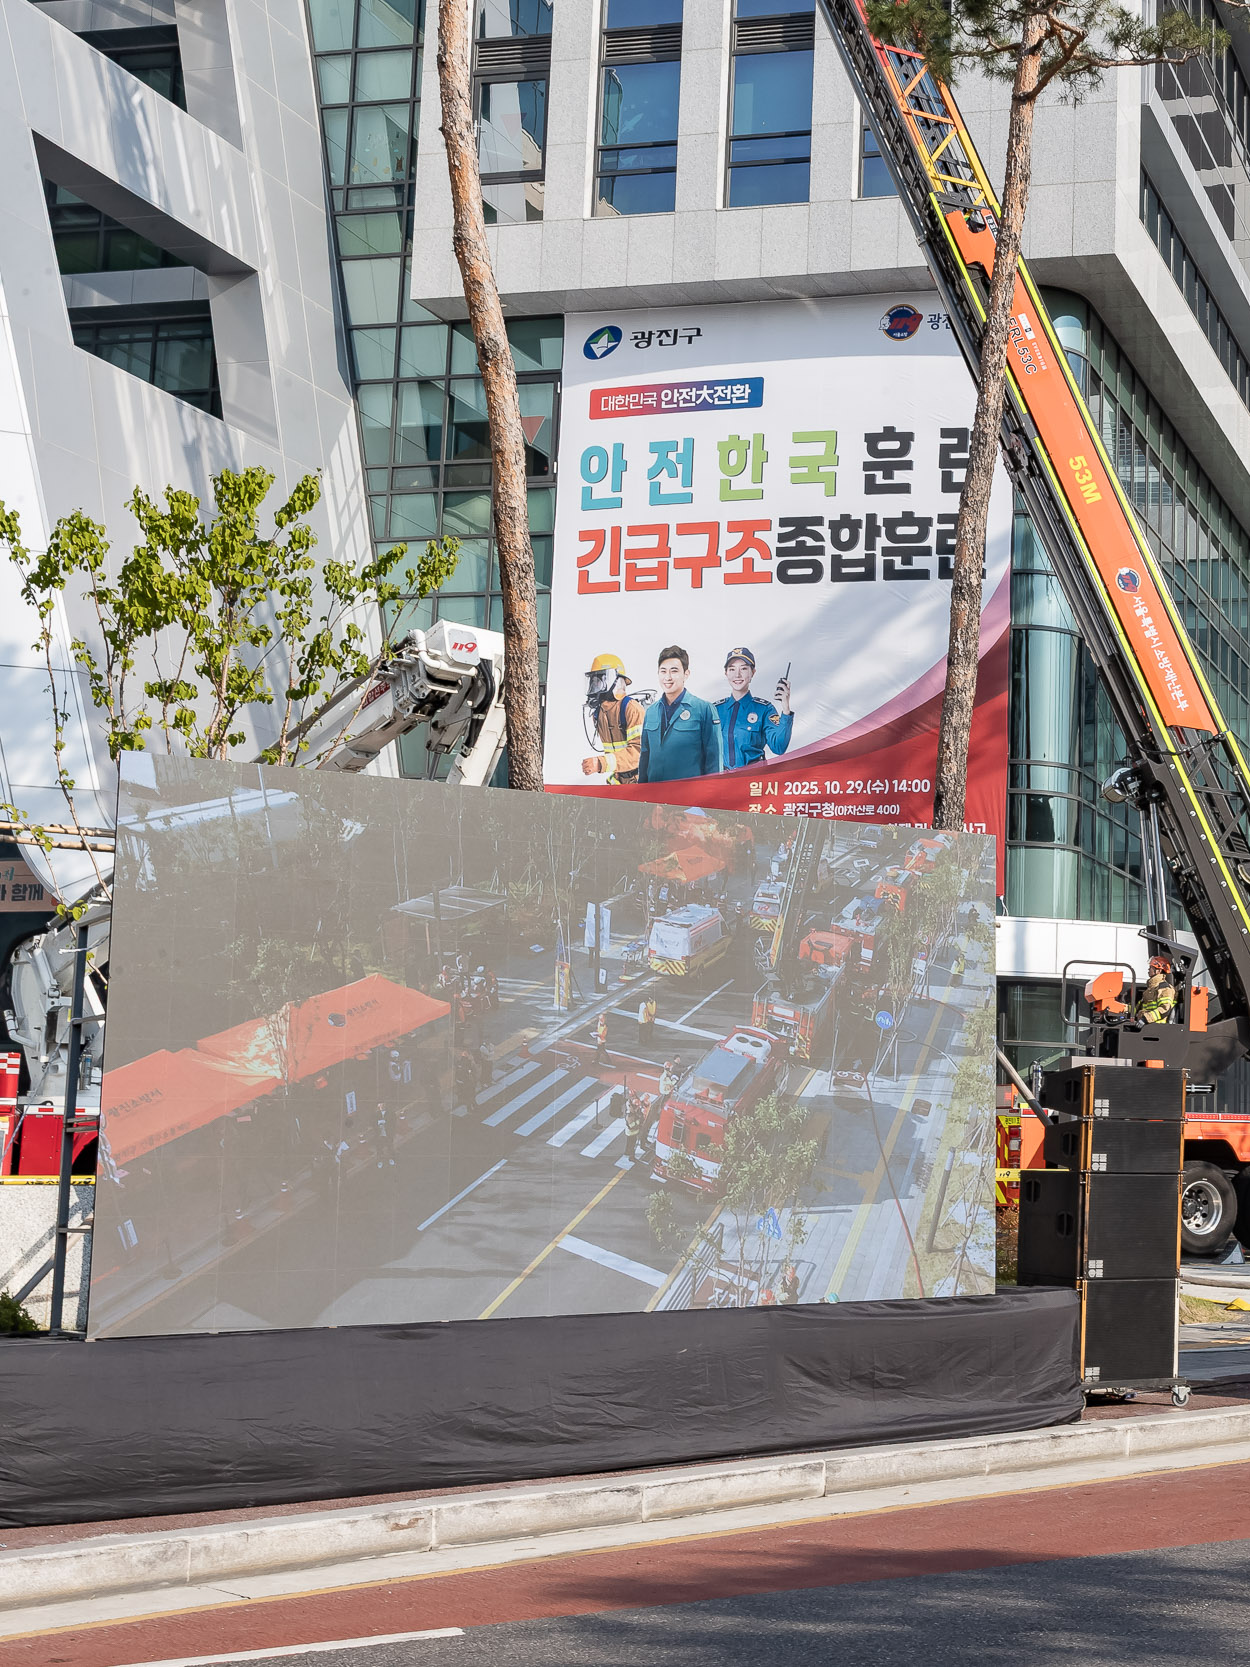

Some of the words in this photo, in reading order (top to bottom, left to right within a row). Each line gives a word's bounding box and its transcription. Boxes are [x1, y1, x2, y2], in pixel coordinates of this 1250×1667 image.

[629, 327, 703, 350] 광진구
[600, 391, 658, 412] 대한민국
[660, 383, 752, 409] 안전大전환
[1068, 455, 1102, 504] 53M
[1133, 596, 1163, 649] 서울특별시
[451, 641, 478, 653] 119
[783, 782, 822, 796] 2025.
[825, 781, 844, 795] 10.
[892, 778, 931, 794] 14:00
[876, 803, 900, 816] 400)
[11, 883, 44, 901] 함께
